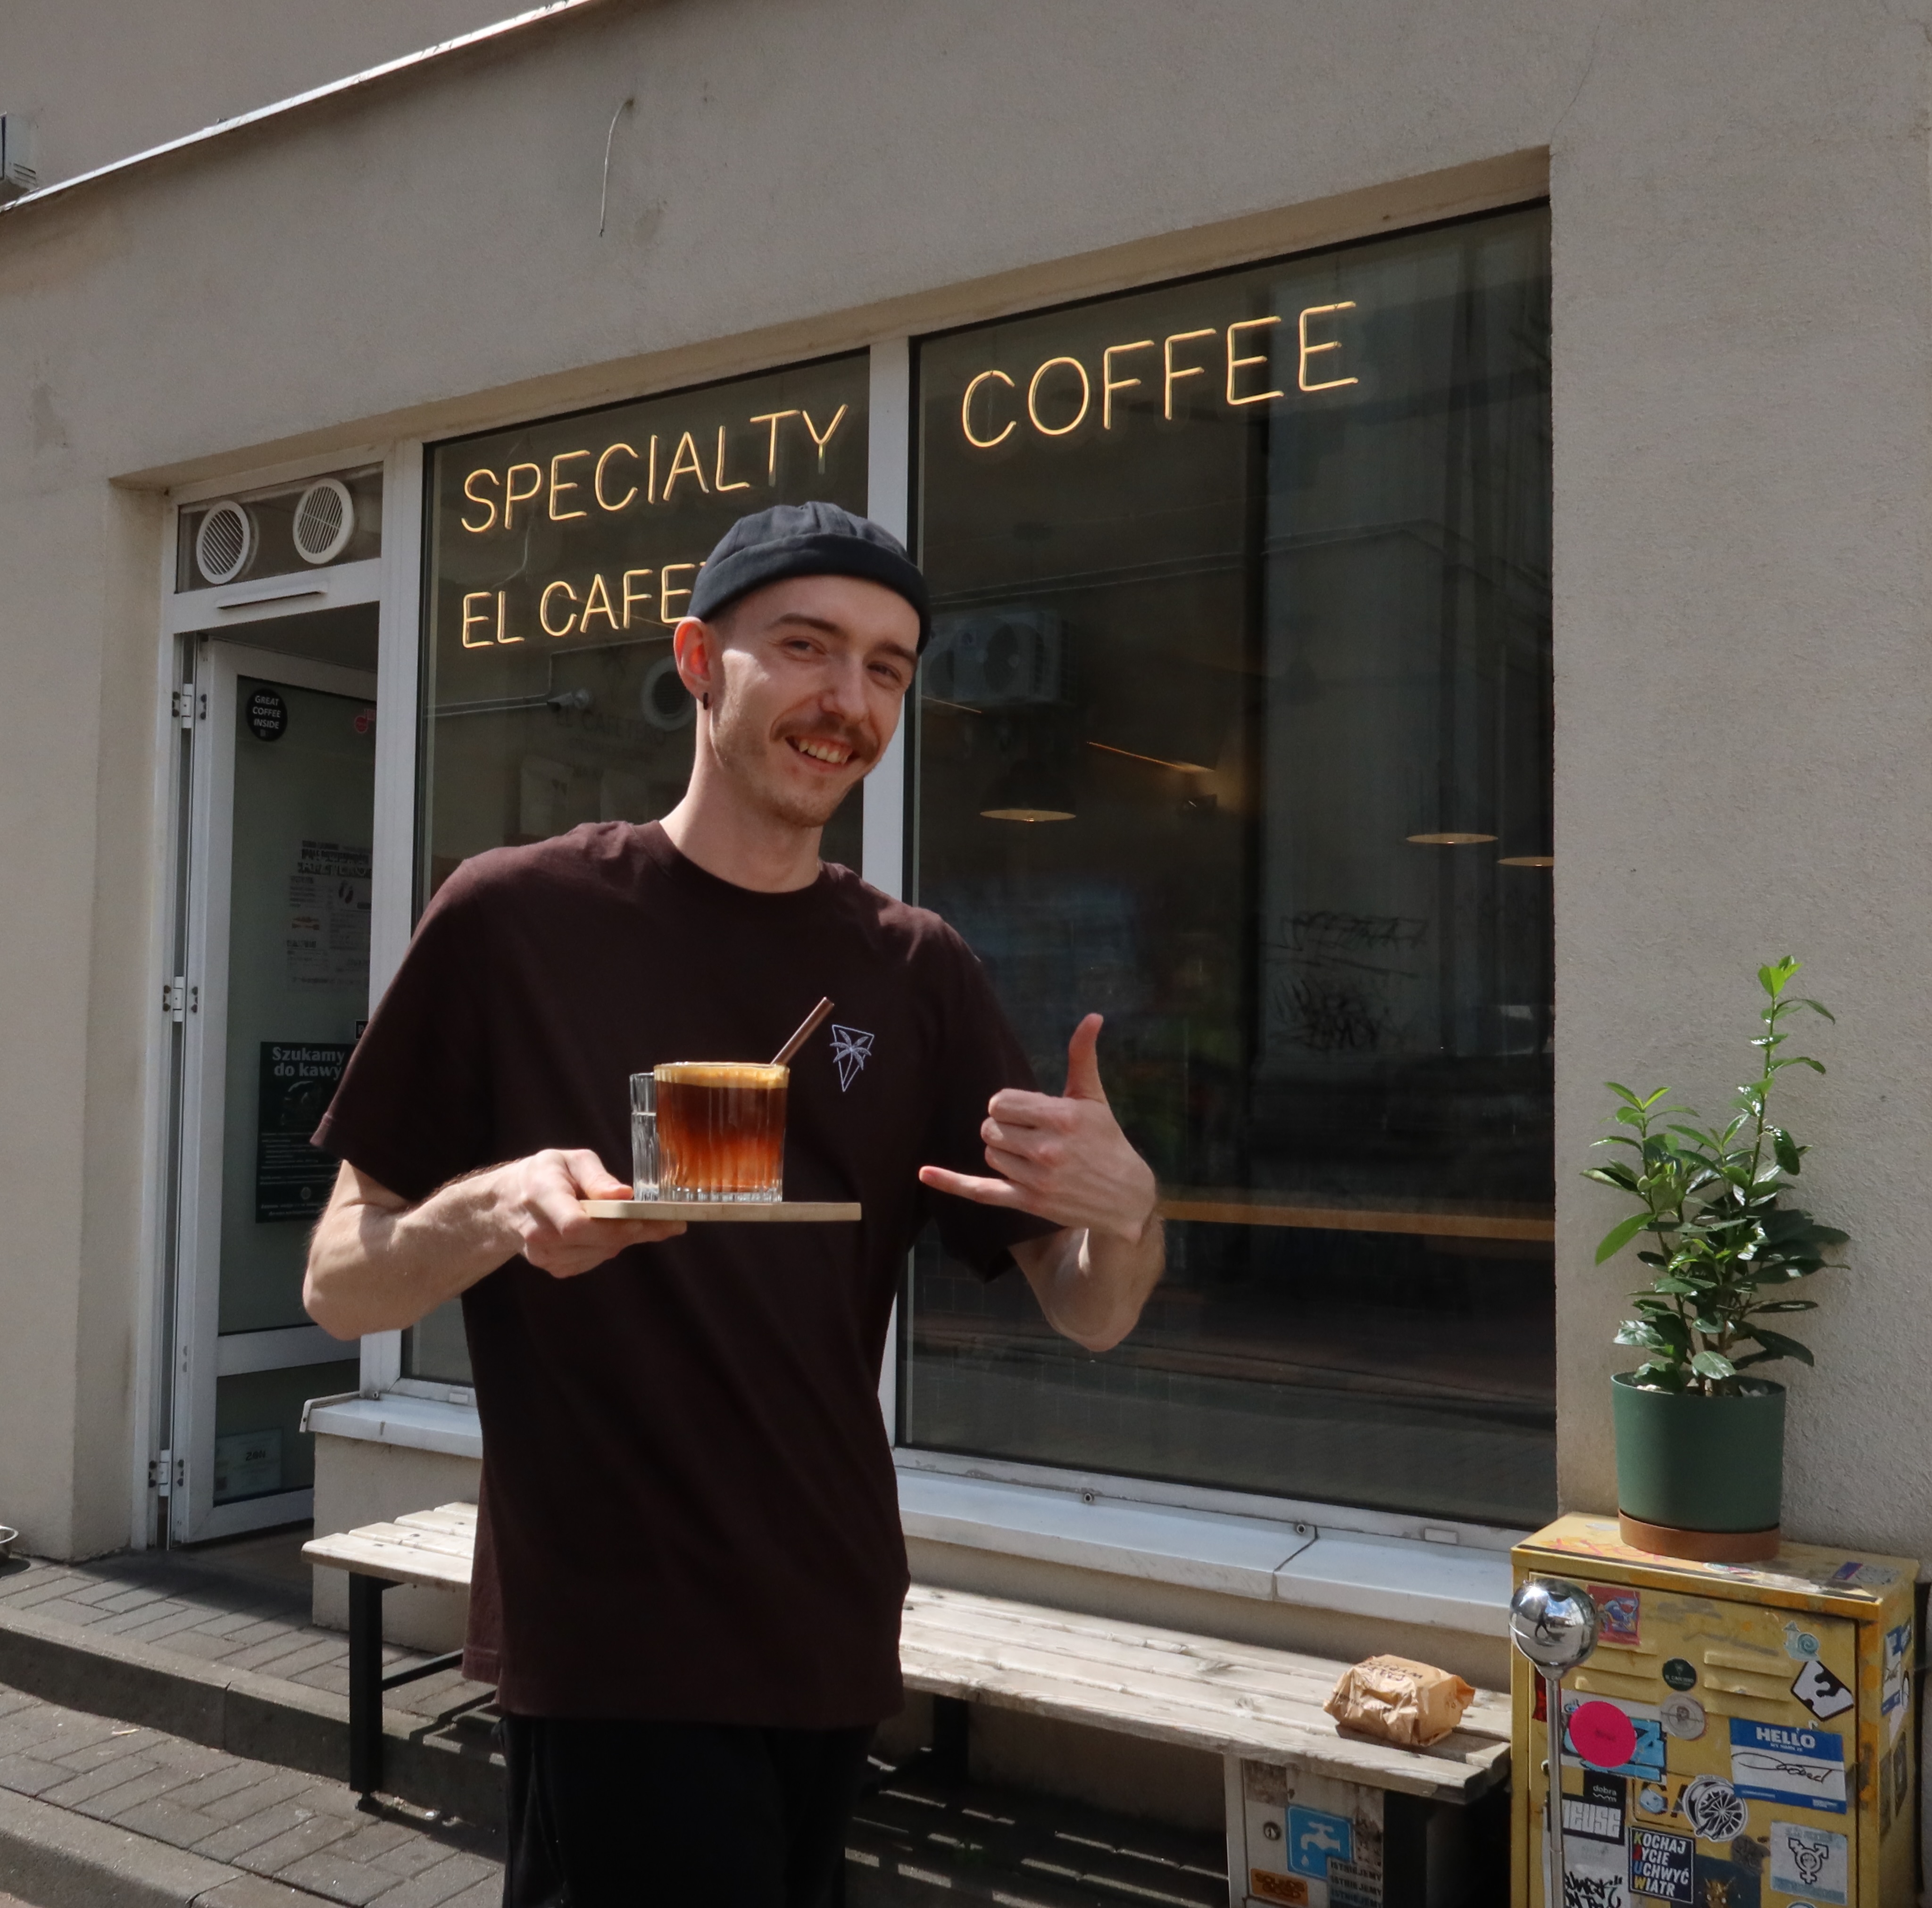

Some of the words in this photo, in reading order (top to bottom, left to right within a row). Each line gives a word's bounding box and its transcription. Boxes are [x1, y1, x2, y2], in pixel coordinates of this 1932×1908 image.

[461, 404, 848, 533] SPECIALTY
[962, 301, 1358, 448] COFFEE
[462, 591, 525, 648] EL
[540, 561, 707, 636] CAFE
[255, 696, 279, 706] GREAT
[252, 706, 281, 718] COFFEE
[253, 718, 279, 729] INSIDE
[272, 1046, 345, 1066] Szukamy
[274, 1062, 295, 1077] do
[299, 1062, 342, 1081] kawy
[1756, 1726, 1816, 1749] HELLO
[1592, 1784, 1617, 1796] dobra
[1633, 1831, 1687, 1855] KOCHAJ
[1633, 1860, 1690, 1885] UCHWYĆ
[1634, 1875, 1676, 1897] WIATR
